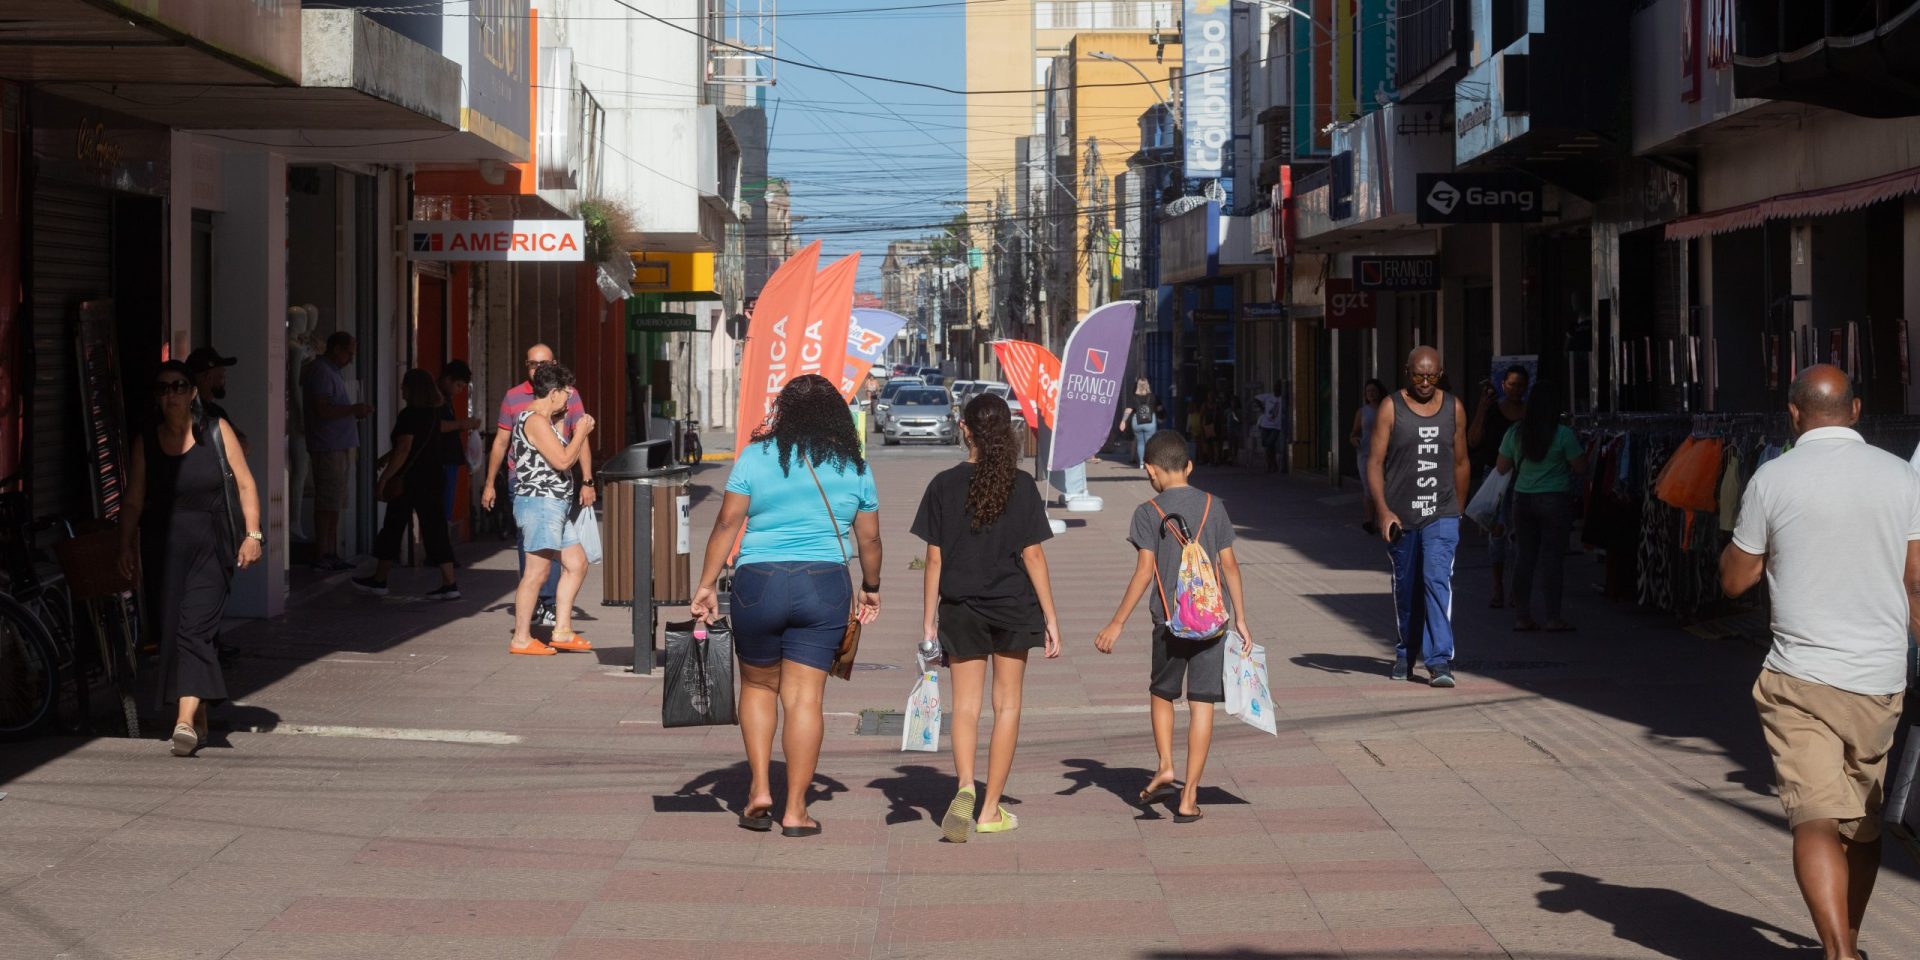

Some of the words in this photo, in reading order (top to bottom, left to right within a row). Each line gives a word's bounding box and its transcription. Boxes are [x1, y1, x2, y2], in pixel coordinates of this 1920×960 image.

[1196, 20, 1227, 171] Colombo
[1466, 187, 1534, 211] Gang
[450, 231, 577, 251] AMÉRICA
[1384, 260, 1433, 277] FRANCO
[1331, 291, 1369, 316] gzt
[636, 318, 663, 328] QUERO
[664, 318, 692, 328] QUERO
[800, 319, 823, 375] ICA
[1067, 374, 1116, 398] FRANCO
[1067, 392, 1112, 405] GIORGI
